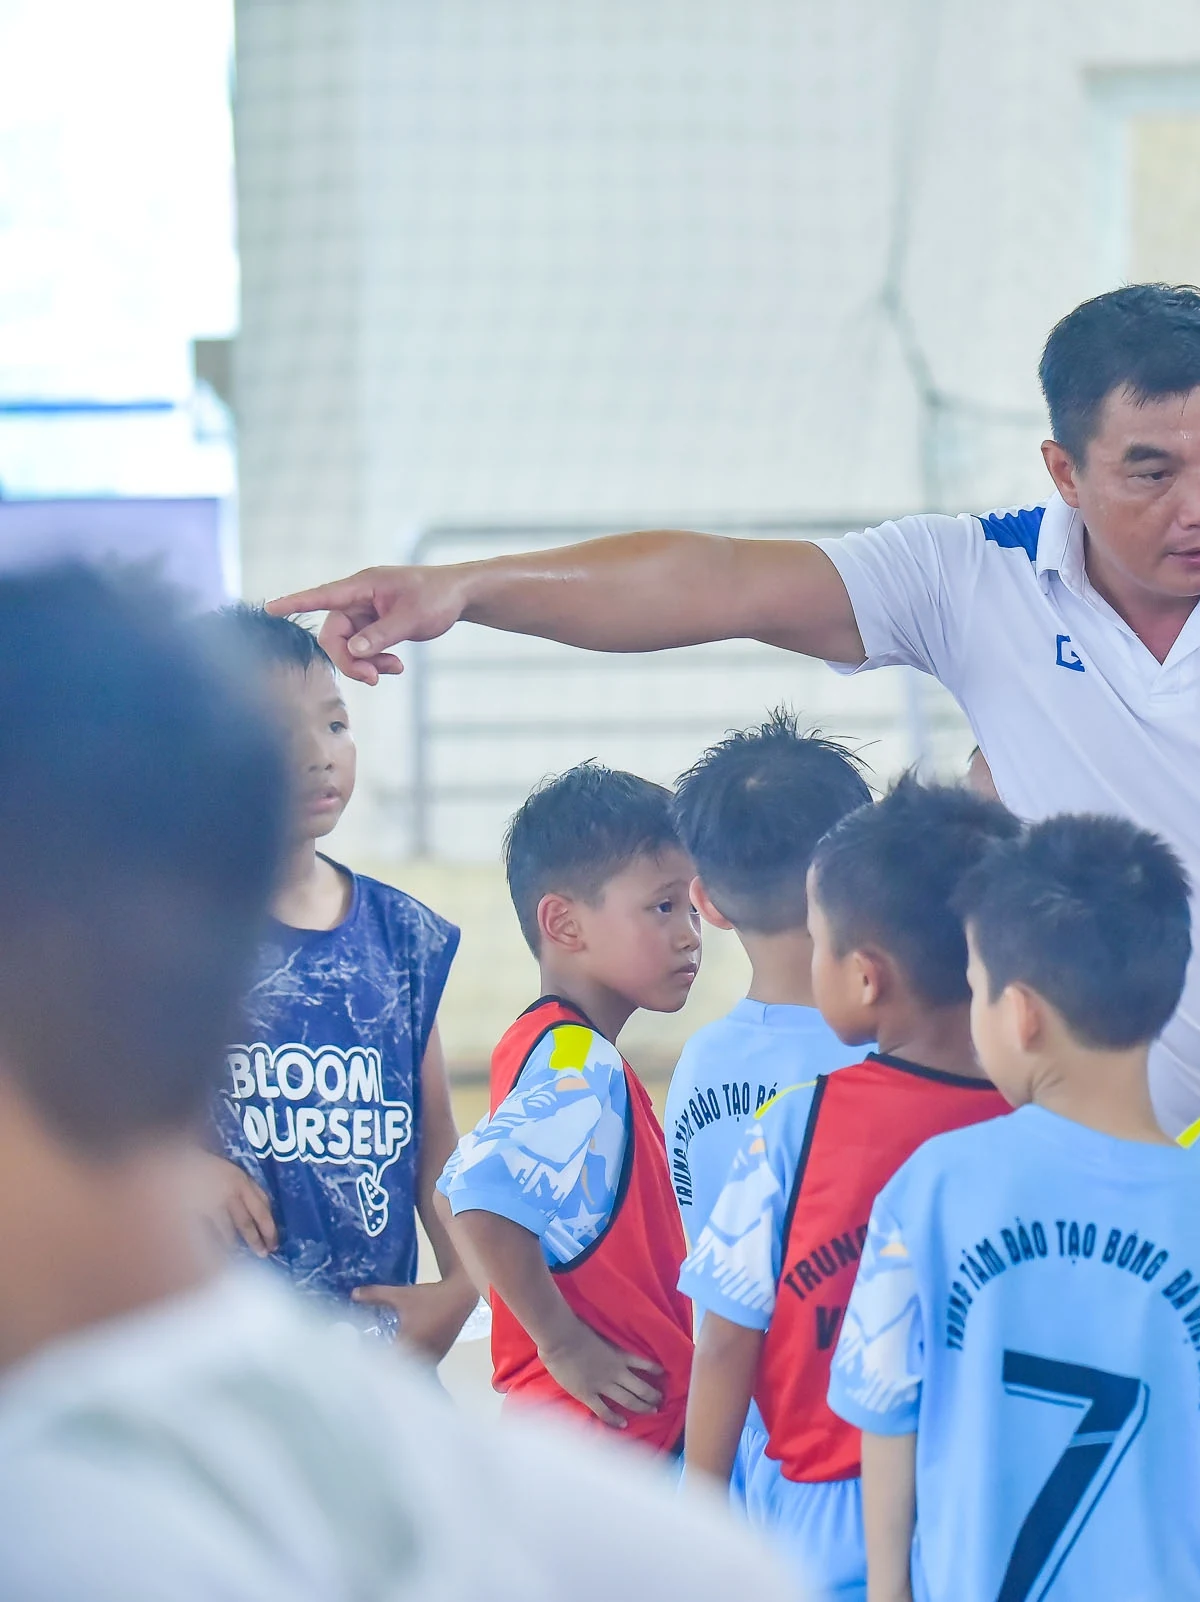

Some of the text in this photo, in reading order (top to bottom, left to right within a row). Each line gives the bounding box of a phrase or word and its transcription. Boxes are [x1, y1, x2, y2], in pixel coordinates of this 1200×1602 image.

[227, 1051, 380, 1103] BLOOM
[688, 1086, 721, 1130] ĐÀO
[722, 1081, 750, 1122] TẠO
[1054, 1218, 1097, 1265] TẠO
[998, 1349, 1150, 1602] 7
